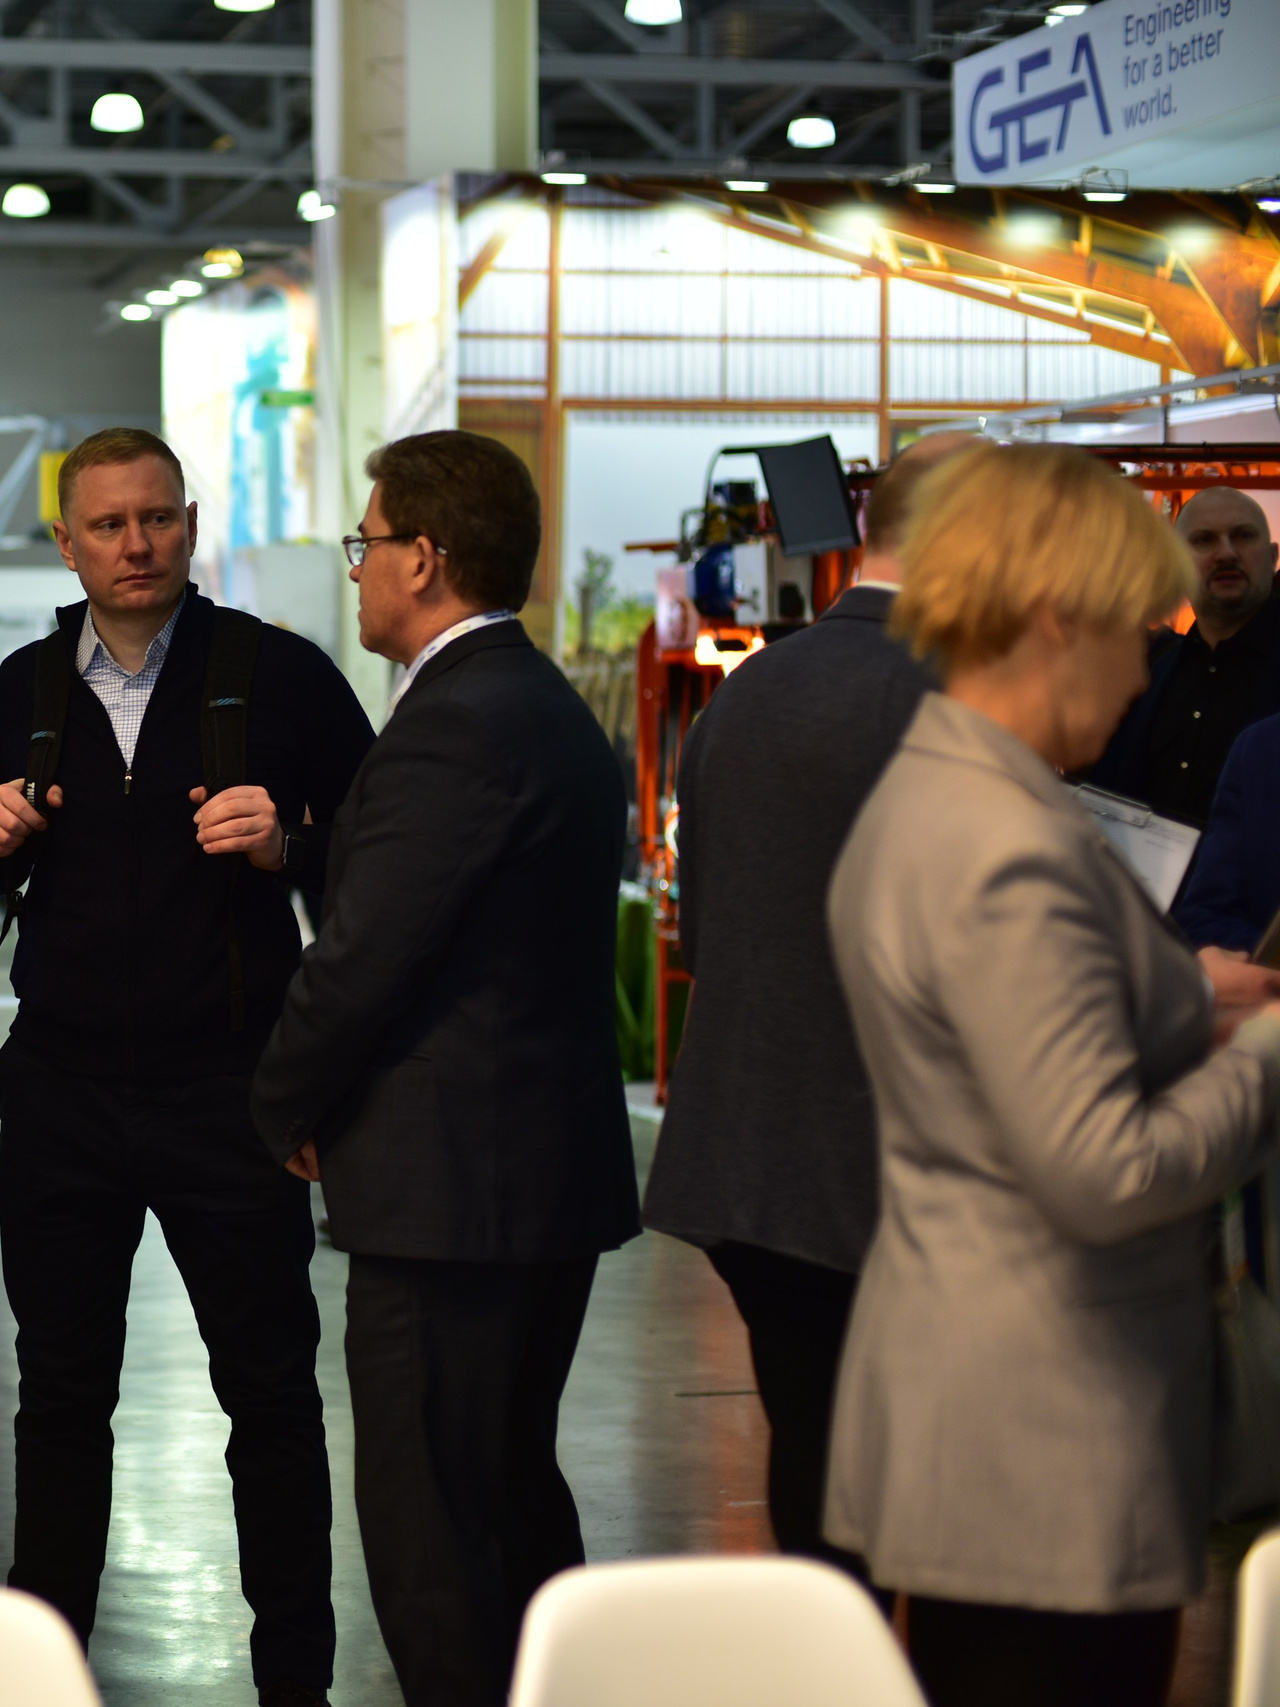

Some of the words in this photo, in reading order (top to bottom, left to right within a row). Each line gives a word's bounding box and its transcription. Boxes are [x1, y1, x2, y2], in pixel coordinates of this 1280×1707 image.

[1124, 0, 1231, 46] Engineering
[1124, 55, 1148, 88] for
[1152, 53, 1162, 77] a
[1168, 28, 1224, 71] better
[969, 32, 1112, 173] GEA
[1124, 84, 1177, 128] world.
